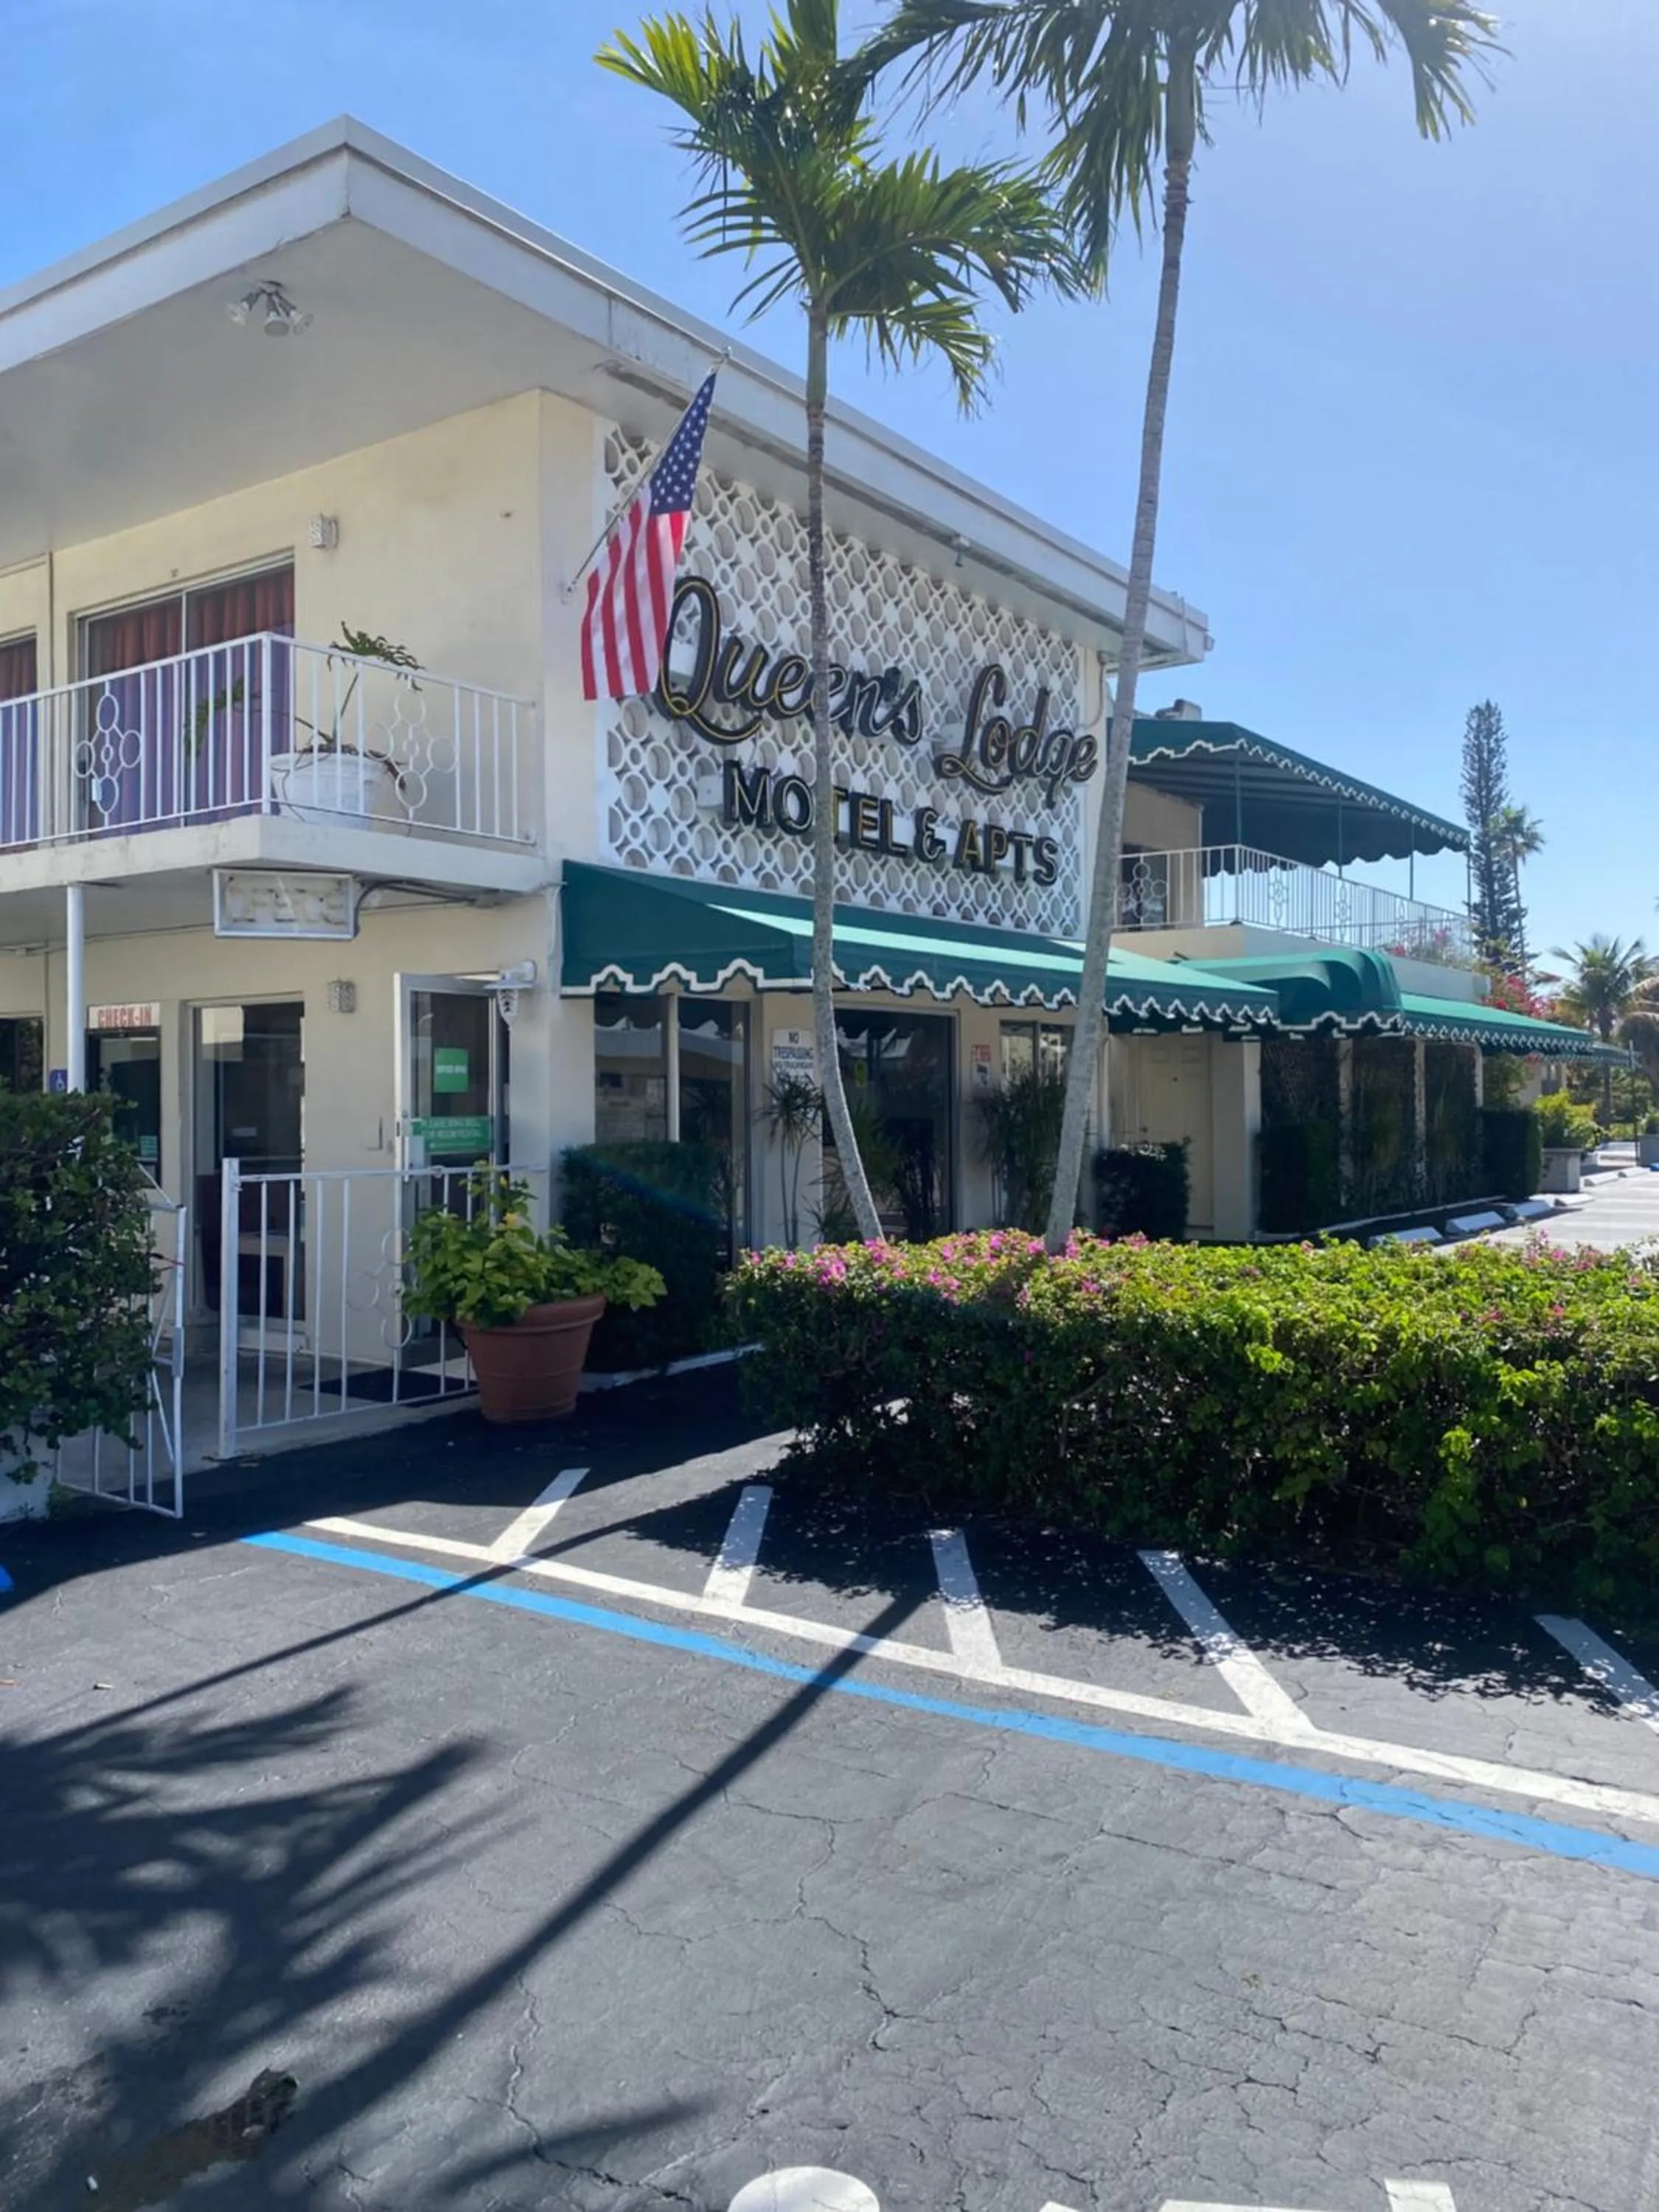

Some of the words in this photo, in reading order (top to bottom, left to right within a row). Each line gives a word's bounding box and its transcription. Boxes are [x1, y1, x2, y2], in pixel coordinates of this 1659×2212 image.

[656, 576, 922, 745] Queen's
[934, 663, 1097, 809] Lodge
[914, 806, 947, 863] &
[952, 818, 1057, 886] APTS
[98, 1006, 152, 1029] CHECK-IN
[788, 1032, 799, 1044] NO
